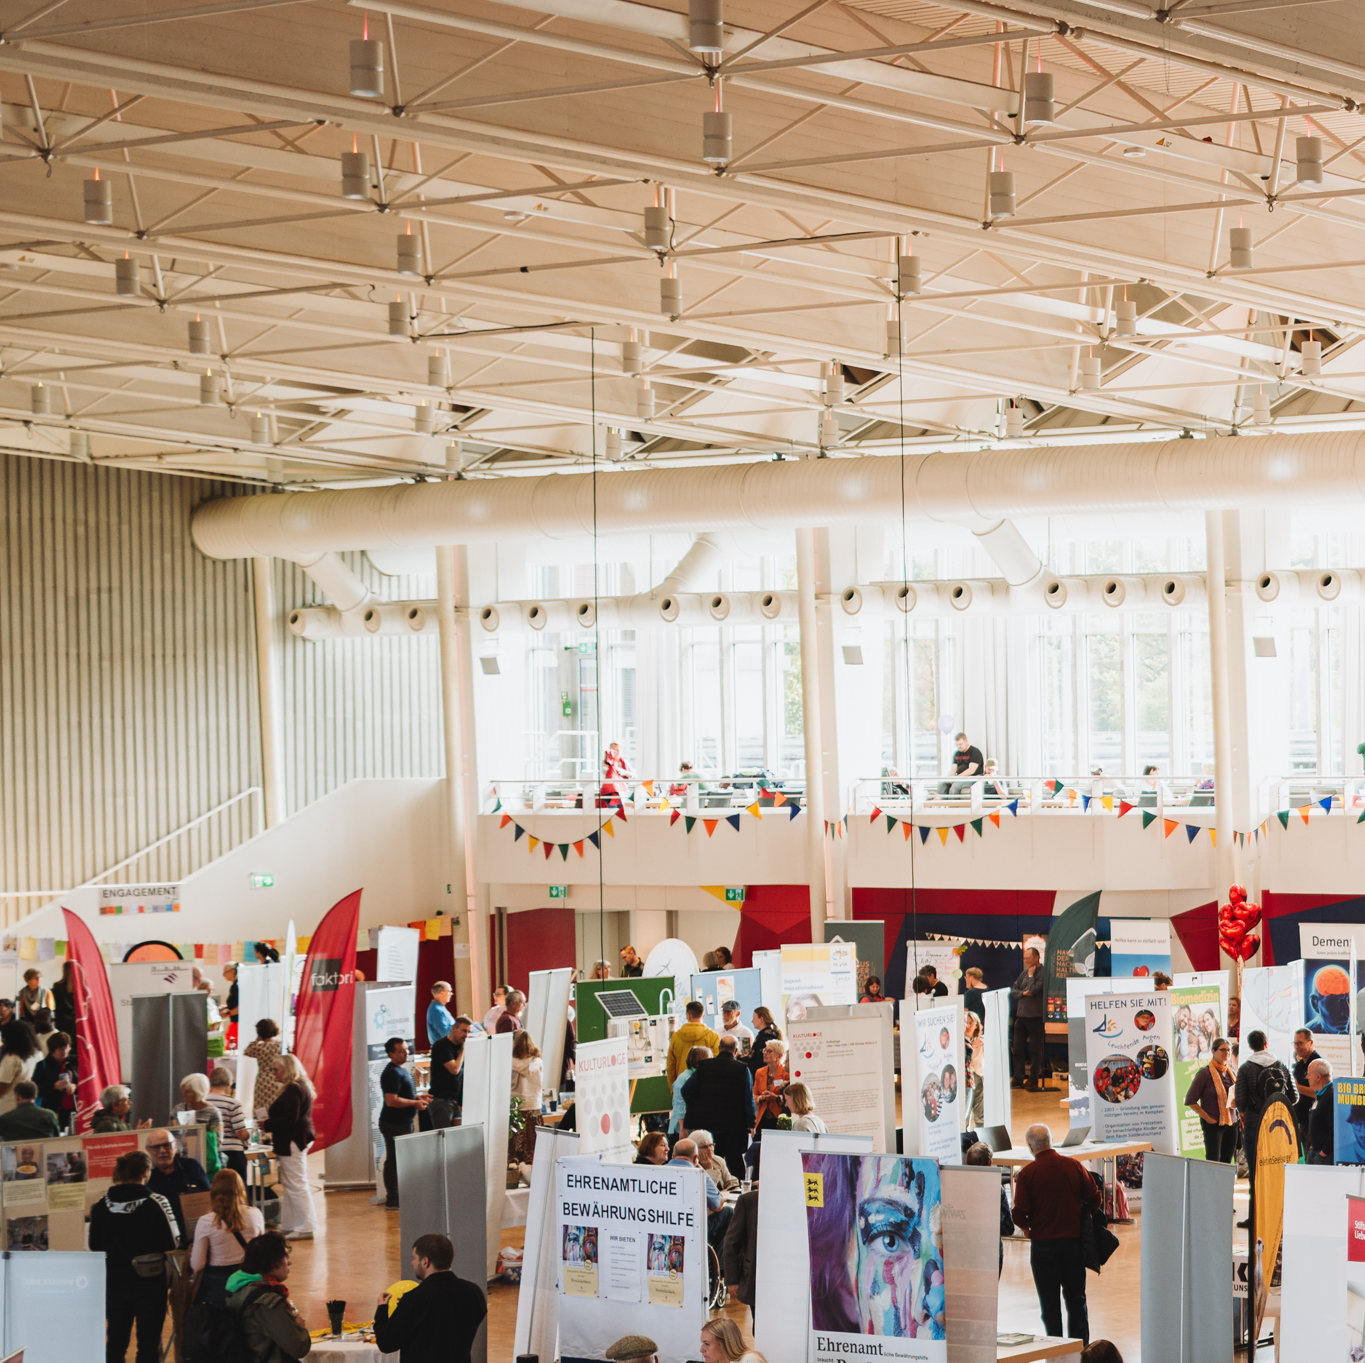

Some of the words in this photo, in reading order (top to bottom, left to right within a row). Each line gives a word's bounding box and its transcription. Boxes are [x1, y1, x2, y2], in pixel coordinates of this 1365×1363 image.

[103, 886, 176, 898] ENGAGEMENT
[311, 971, 354, 987] faktori
[1090, 1000, 1127, 1010] HELFEN
[1130, 999, 1144, 1008] SIE
[1148, 998, 1166, 1006] MIT!
[1171, 991, 1219, 1005] Biomedizin
[917, 1019, 927, 1027] WIR
[928, 1016, 945, 1027] SUCHEN
[1108, 1038, 1140, 1050] Leuchtende
[1142, 1034, 1160, 1042] Augen
[578, 1052, 625, 1072] KULTURLOGE
[1338, 1083, 1351, 1093] BIG
[1338, 1094, 1365, 1106] MUMBLE
[567, 1174, 677, 1195] EHRENAMTLICHE
[563, 1201, 694, 1227] BEWÄHRUNGSHILFE
[816, 1337, 883, 1356] Ehrenamt
